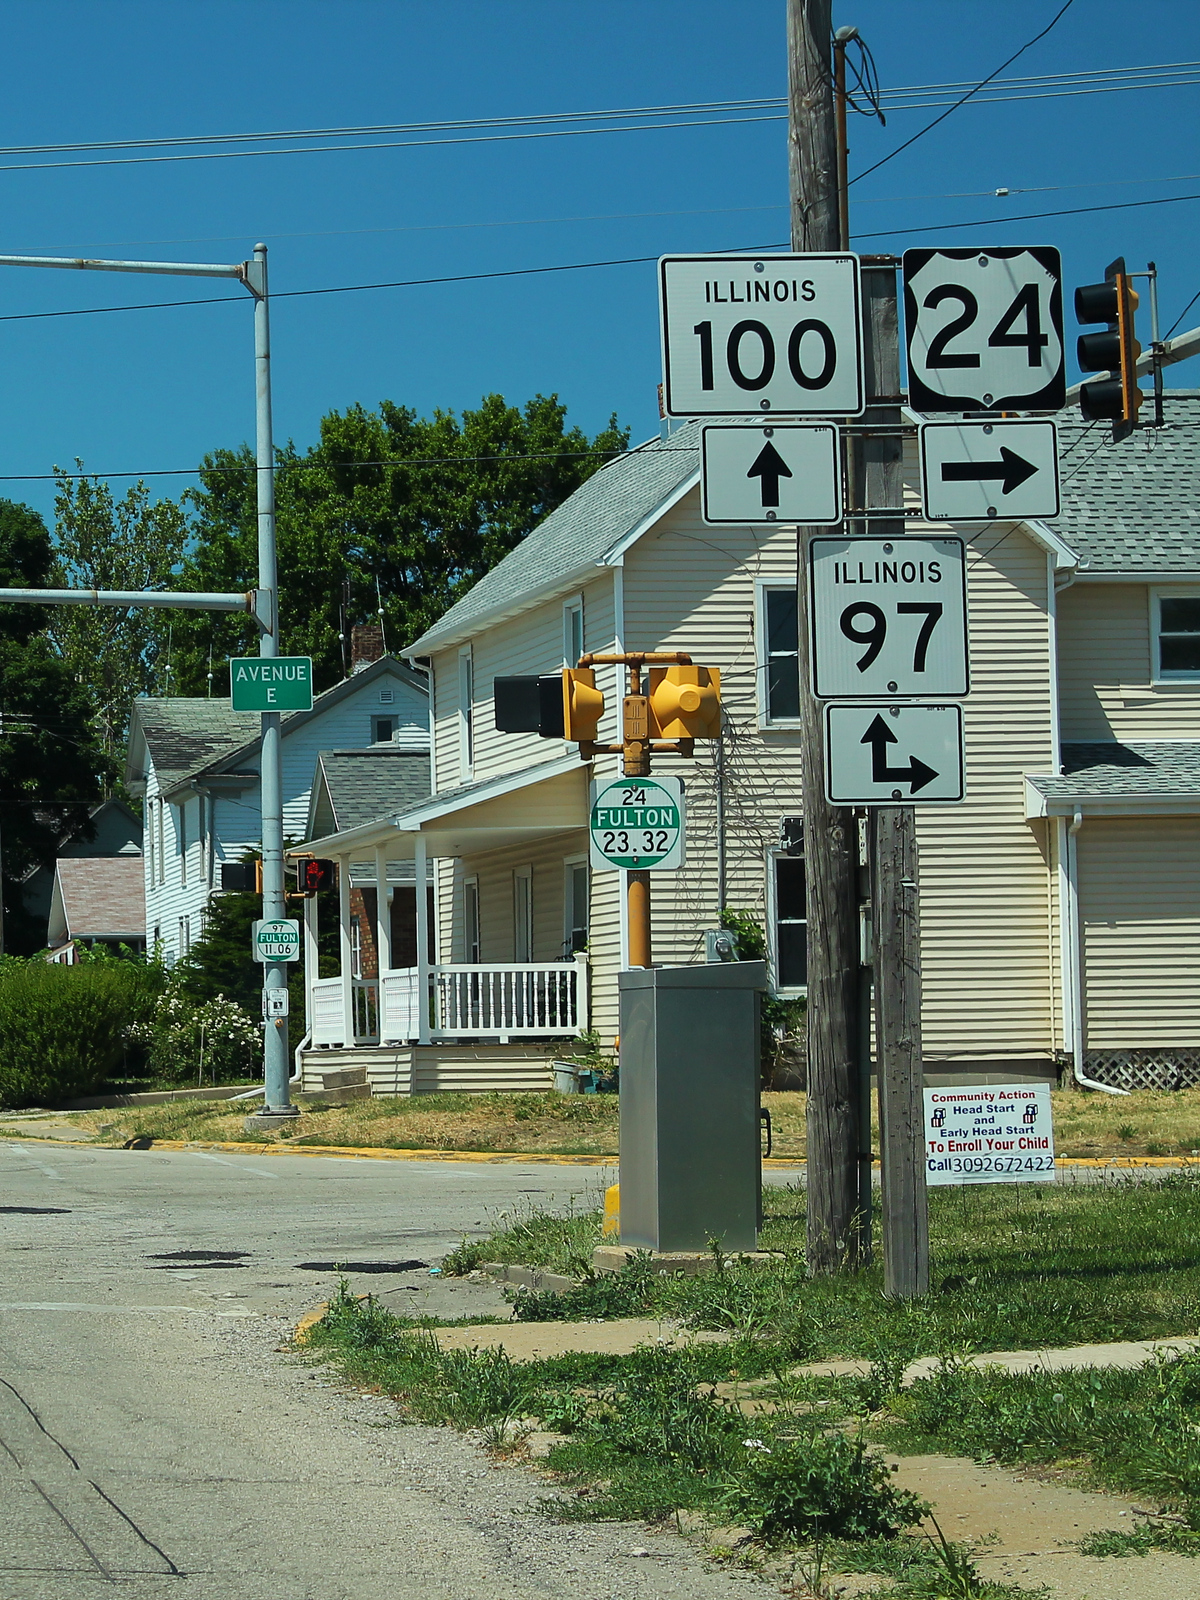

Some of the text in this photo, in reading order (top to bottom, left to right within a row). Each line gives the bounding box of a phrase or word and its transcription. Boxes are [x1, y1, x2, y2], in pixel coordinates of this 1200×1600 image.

[705, 279, 816, 303] ILLINOIS
[921, 282, 1049, 370] 24
[693, 318, 837, 392] 100
[834, 561, 943, 585] ILLINOIS
[839, 600, 944, 674] 97
[236, 665, 307, 682] AVENUE
[266, 687, 277, 703] E
[621, 788, 647, 806] 24
[597, 808, 673, 828] FULTON
[603, 830, 669, 853] 23.32
[272, 924, 284, 933] 97
[260, 933, 296, 943] FULTON
[265, 943, 291, 954] 11.06
[931, 1090, 1036, 1103] Community Action
[953, 1104, 1015, 1114] Head Start
[973, 1116, 995, 1125] and
[940, 1125, 1035, 1138] Early Head Start
[928, 1136, 1049, 1153] To Enroll Your Child
[928, 1156, 1056, 1172] Call 3092672422
